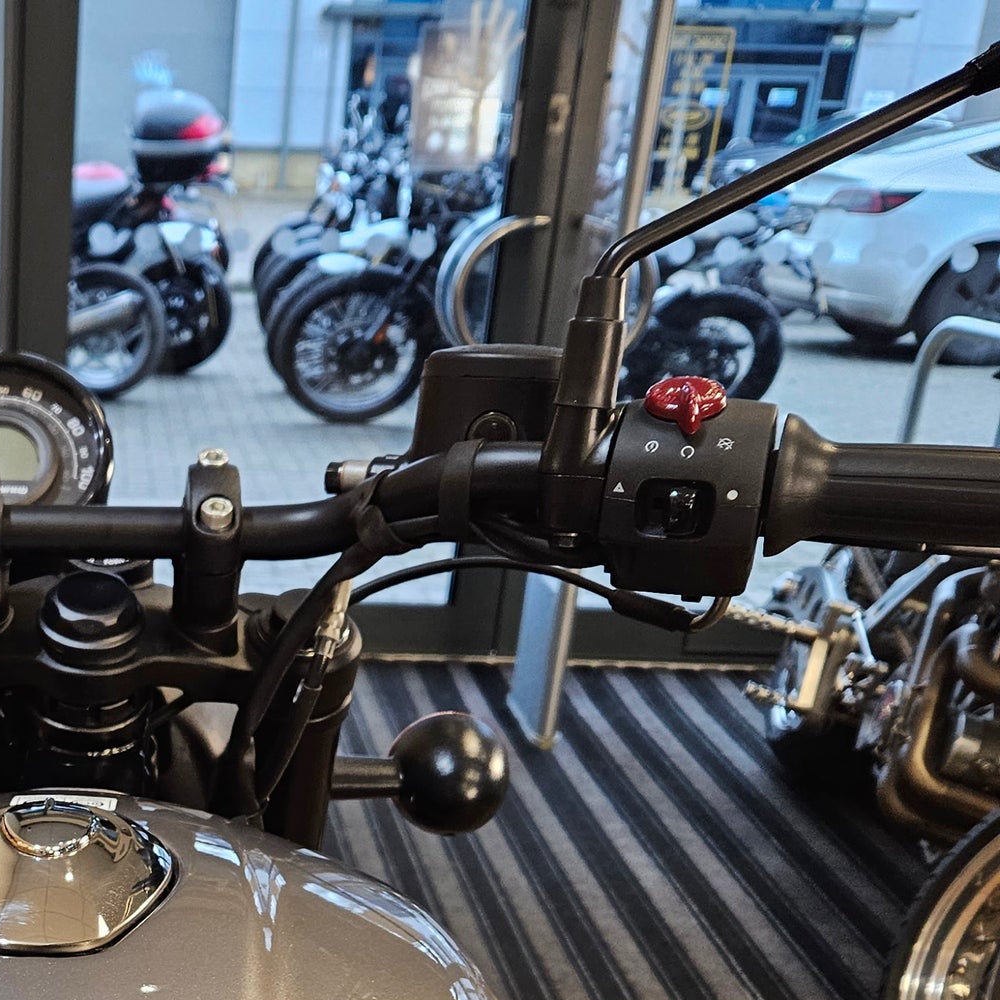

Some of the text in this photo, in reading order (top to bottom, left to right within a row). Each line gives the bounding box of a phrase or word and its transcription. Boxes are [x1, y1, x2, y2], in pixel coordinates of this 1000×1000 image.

[22, 386, 43, 402] 60
[49, 402, 63, 415] 70
[66, 416, 86, 437] 80
[78, 465, 95, 491] 100
